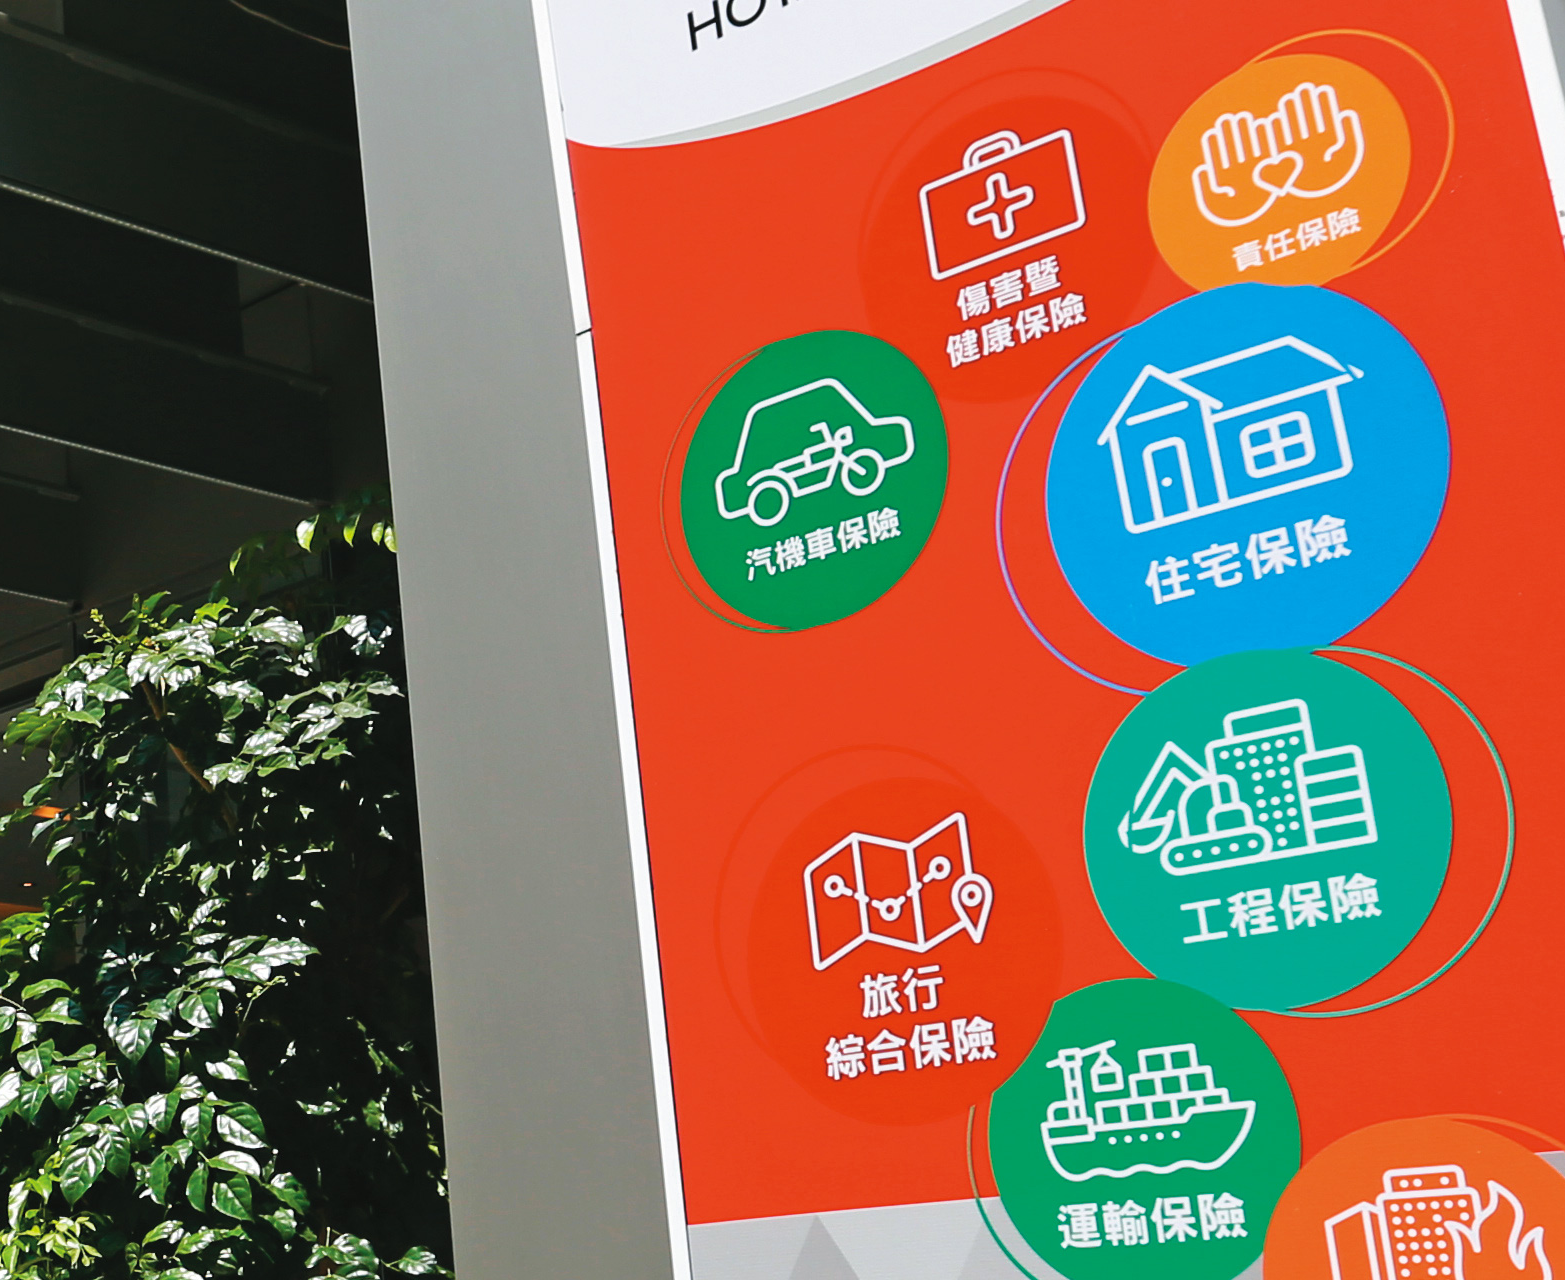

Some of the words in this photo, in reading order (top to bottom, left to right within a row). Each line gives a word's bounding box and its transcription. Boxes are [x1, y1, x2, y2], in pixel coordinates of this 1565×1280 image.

[1233, 207, 1362, 272] 責任保險
[956, 255, 1062, 321] 傷害暨
[945, 292, 1088, 369] 健康保險
[745, 506, 902, 581] 汽機車保險
[1144, 514, 1354, 605] 住宅保險
[1180, 872, 1384, 945] 工程保險
[859, 964, 944, 1018] 旅行
[824, 1015, 998, 1081] 綜合保險
[1057, 1191, 1250, 1251] 運輸保險
